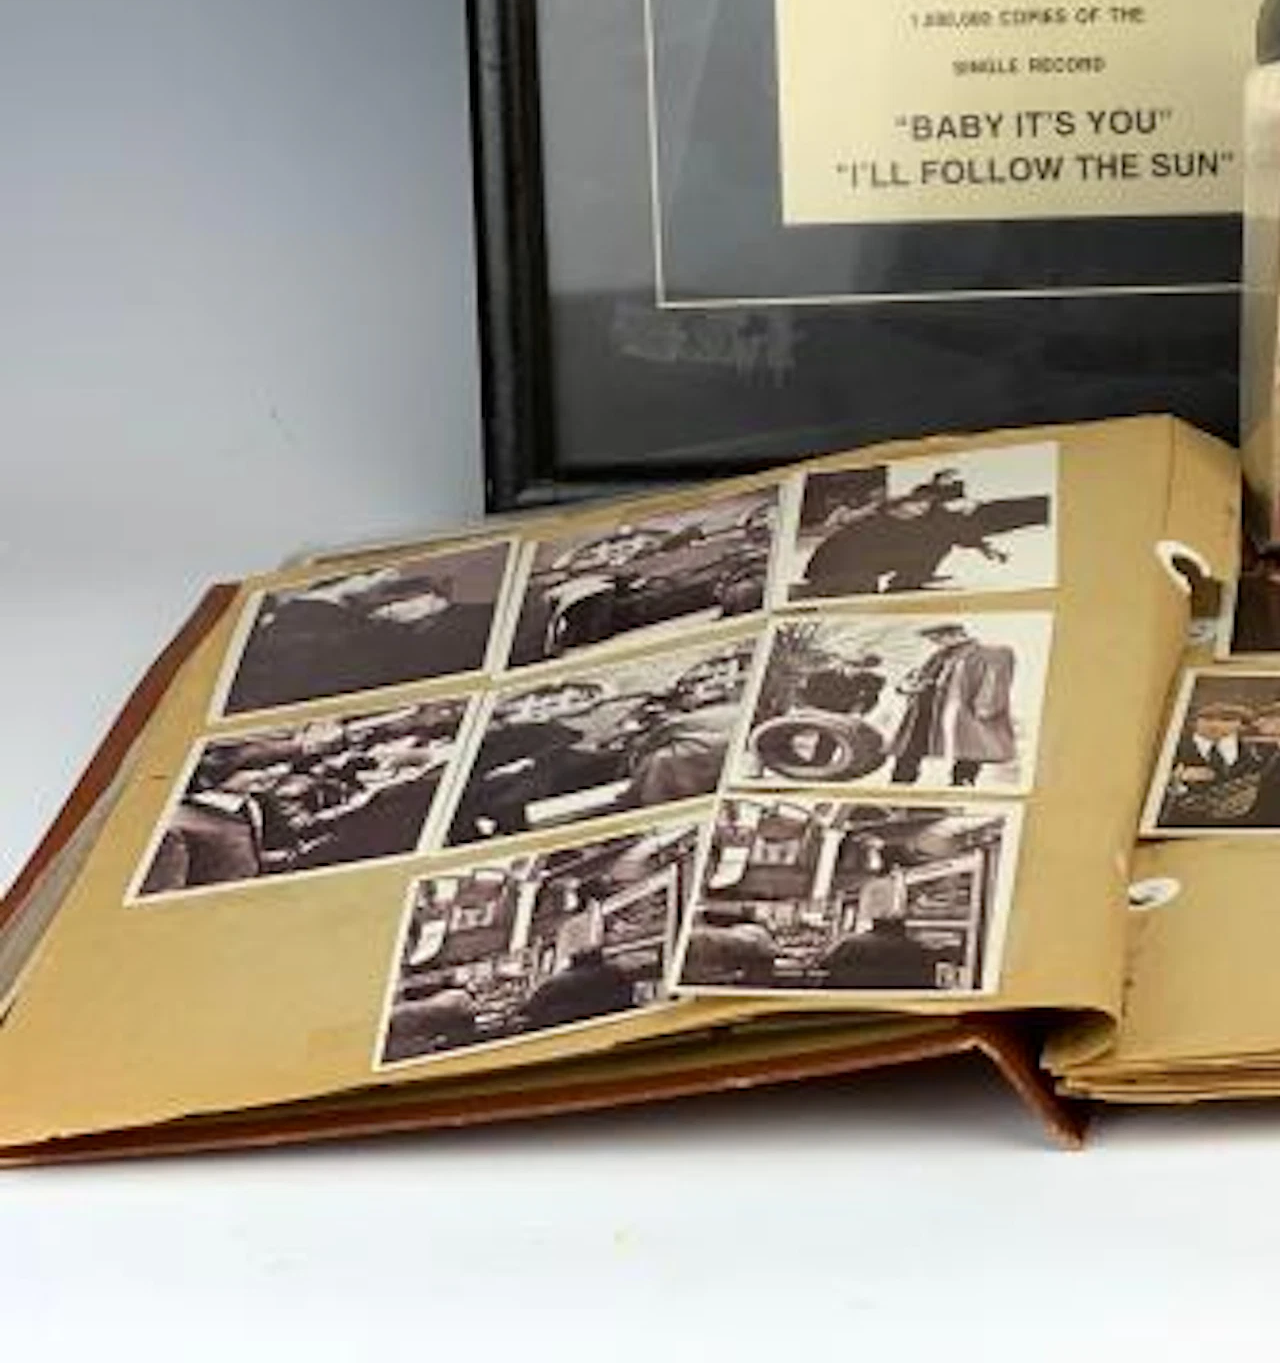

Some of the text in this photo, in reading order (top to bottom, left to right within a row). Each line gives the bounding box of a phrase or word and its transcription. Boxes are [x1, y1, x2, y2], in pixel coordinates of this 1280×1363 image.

[1075, 7, 1101, 25] OF
[1108, 6, 1147, 24] THE
[1029, 56, 1107, 74] RECORD
[1016, 112, 1077, 137] IT'S
[919, 156, 1066, 186] FOLLOW
[1076, 154, 1141, 181] THE
